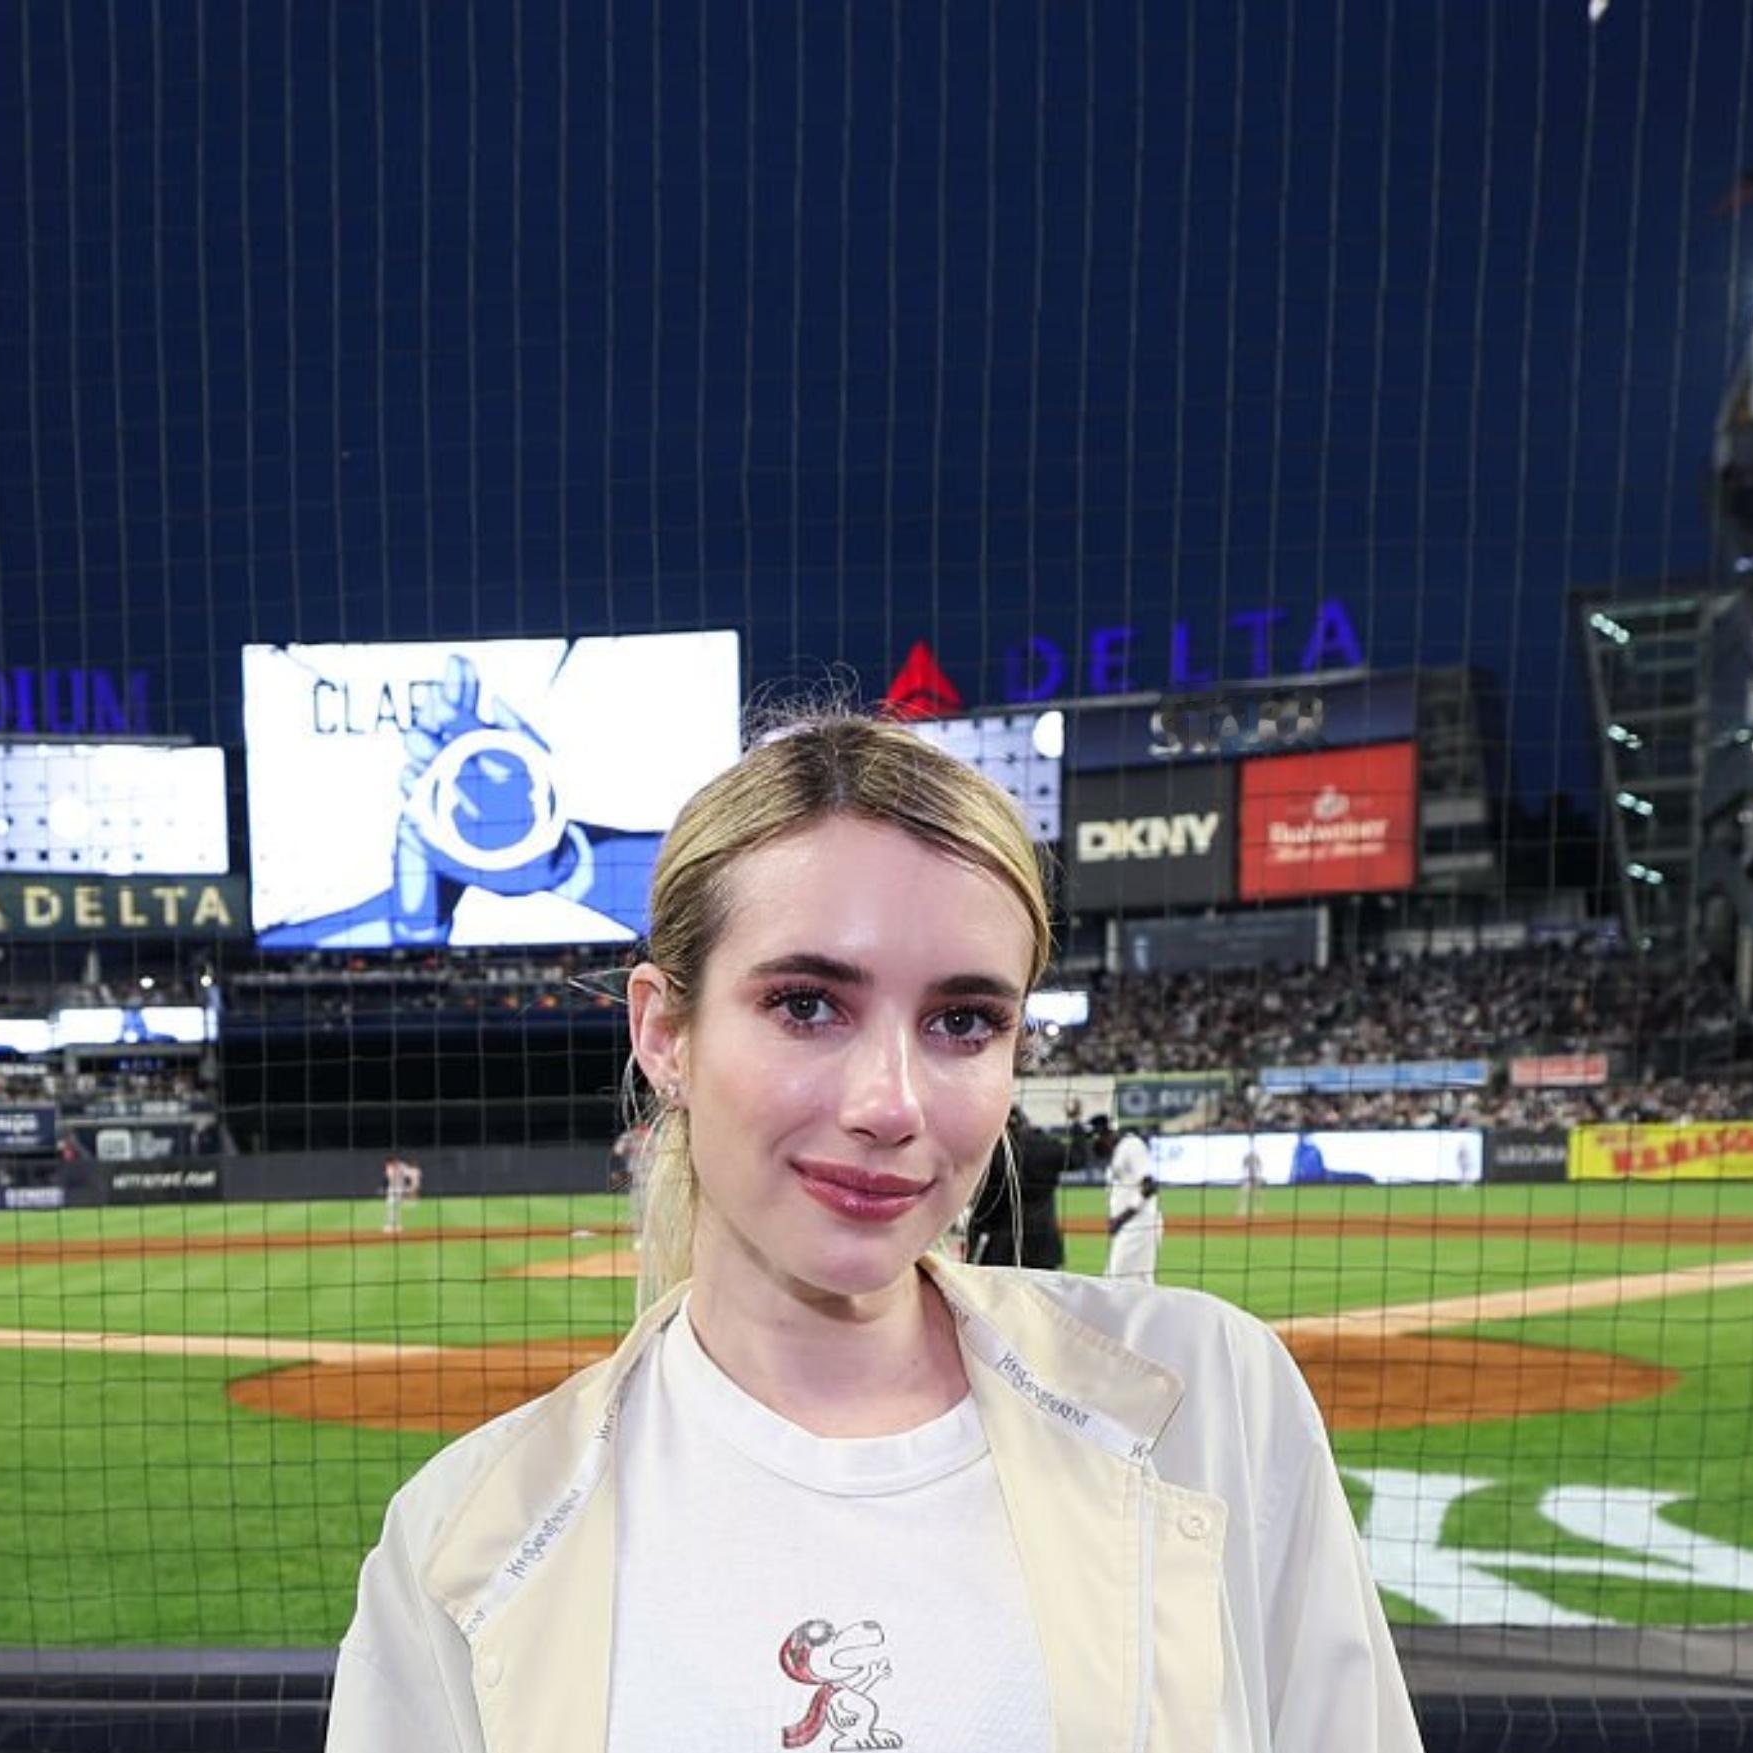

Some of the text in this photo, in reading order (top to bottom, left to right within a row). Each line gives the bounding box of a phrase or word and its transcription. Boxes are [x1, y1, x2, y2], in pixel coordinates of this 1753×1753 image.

[1003, 598, 1364, 704] DELTA
[1076, 811, 1220, 862] DKNY
[22, 885, 232, 927] DELTA
